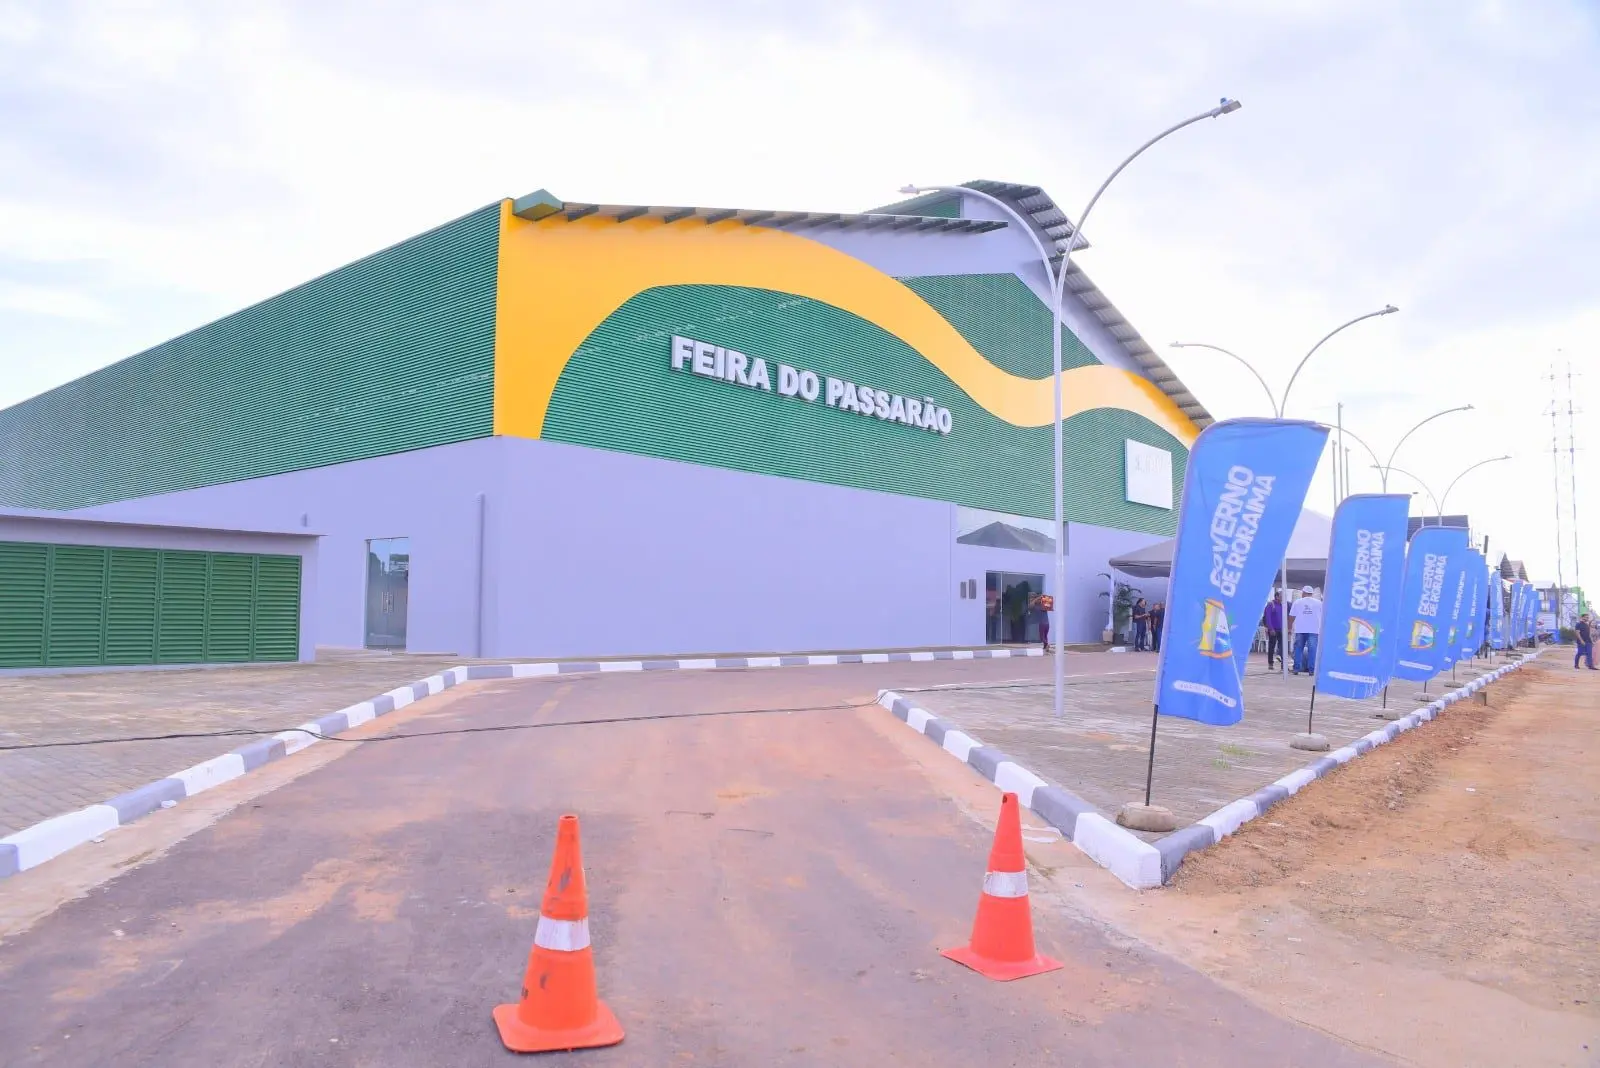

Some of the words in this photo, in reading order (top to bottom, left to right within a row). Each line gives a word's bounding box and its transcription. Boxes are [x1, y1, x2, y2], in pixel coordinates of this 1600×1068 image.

[671, 335, 771, 391] FEIRA
[777, 363, 819, 400] DO
[825, 376, 952, 434] PASSARÃO
[1226, 476, 1276, 568] RORAIMA
[1221, 567, 1241, 597] DE
[1351, 529, 1371, 610] GOVERNO
[1369, 531, 1385, 593] RORAIMA
[1418, 553, 1437, 616] GOVERNO
[1430, 555, 1448, 602] RORAIMA
[1368, 594, 1380, 612] DE
